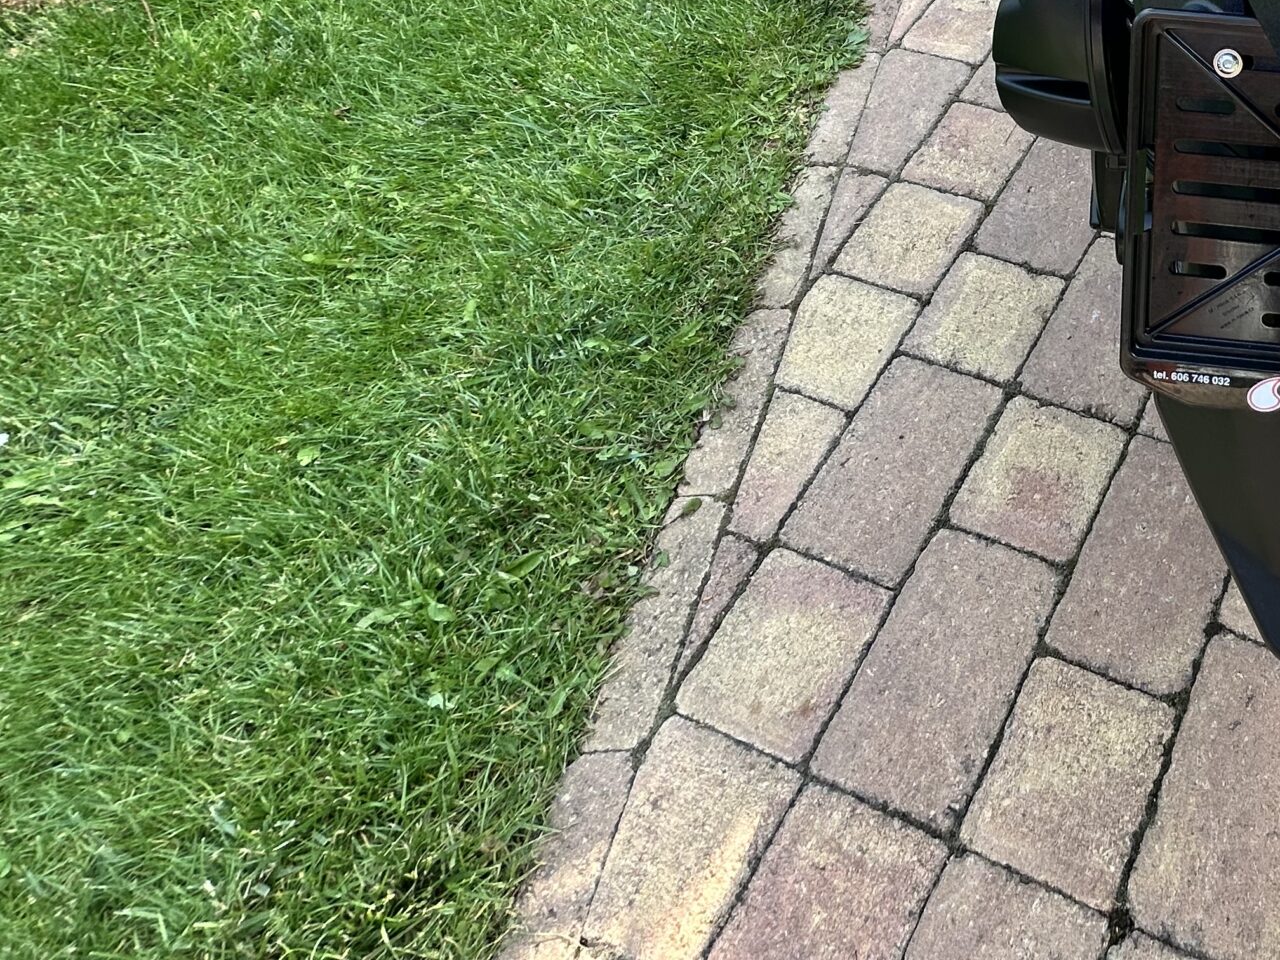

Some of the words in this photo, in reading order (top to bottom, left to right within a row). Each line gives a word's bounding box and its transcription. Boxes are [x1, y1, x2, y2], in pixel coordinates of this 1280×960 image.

[1153, 370, 1169, 380] tel.
[1171, 372, 1190, 382] 606
[1192, 374, 1210, 384] 746
[1211, 376, 1231, 386] 032
